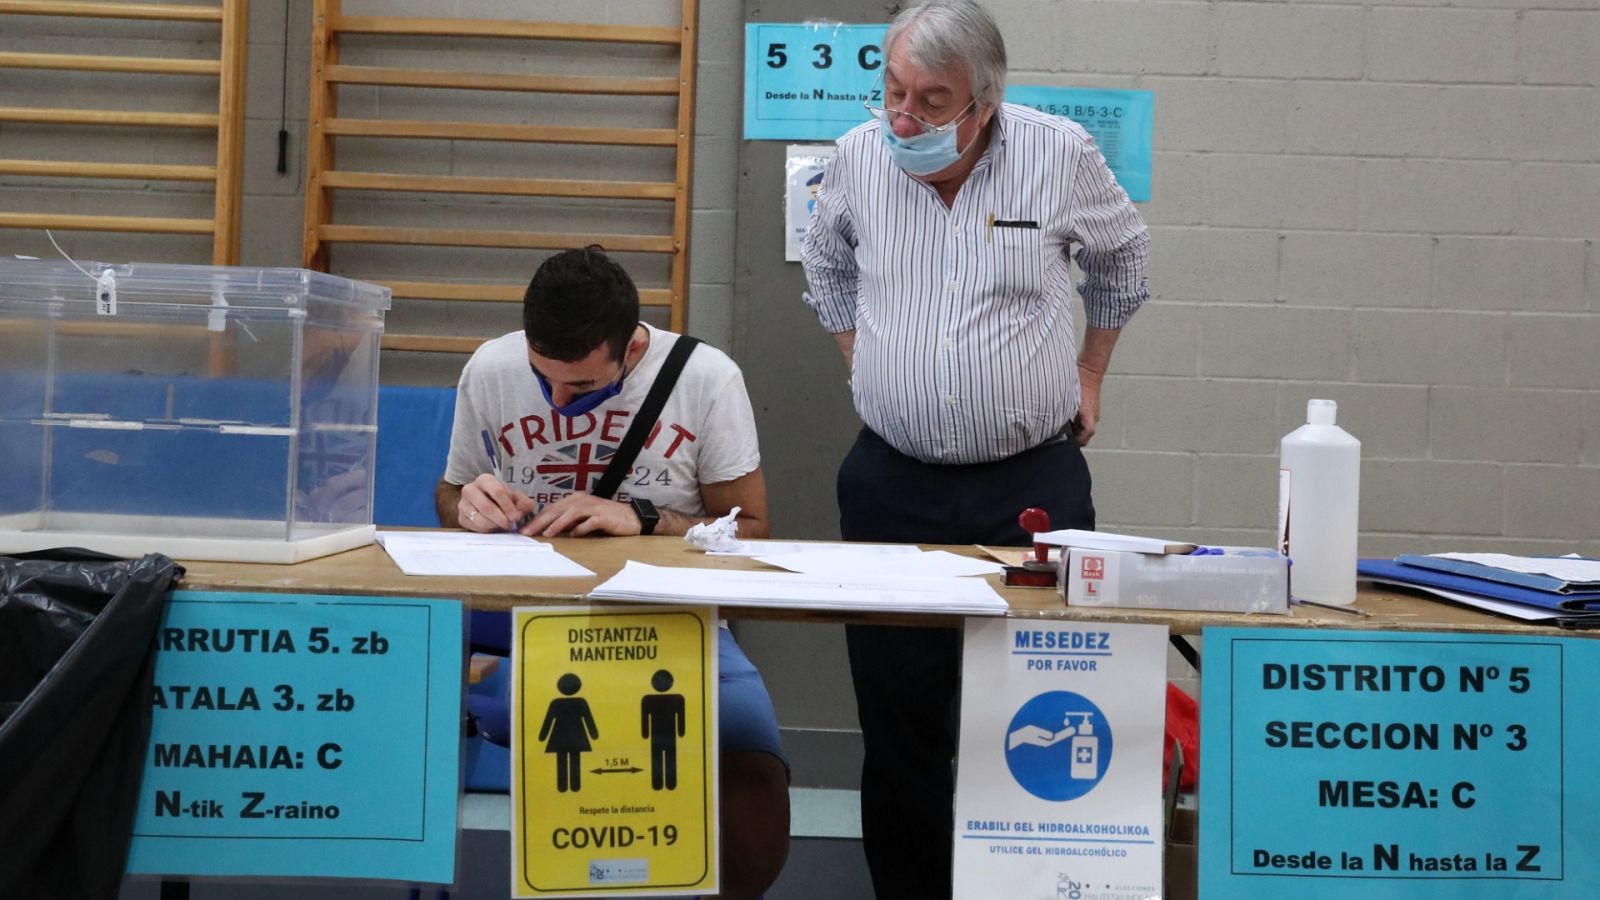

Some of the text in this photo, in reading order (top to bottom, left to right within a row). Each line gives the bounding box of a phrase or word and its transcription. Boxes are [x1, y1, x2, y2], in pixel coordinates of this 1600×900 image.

[767, 43, 881, 70] 5 3 C
[766, 92, 797, 100] Desde
[813, 89, 824, 99] N
[827, 92, 856, 100] hasta
[859, 93, 868, 101] la
[871, 90, 881, 101] Z
[507, 466, 672, 487] 19 24
[1087, 582, 1097, 593] L
[308, 627, 340, 654] 5.
[351, 631, 389, 655] zb
[568, 626, 659, 643] DISTANTZIA
[1015, 630, 1110, 650] MESEDEZ
[570, 645, 658, 662] MANTENDU
[1027, 659, 1097, 671] POR FAVOR
[1262, 663, 1446, 692] DISTRITO
[1508, 667, 1531, 693] 5
[273, 684, 305, 712] 3.
[316, 688, 355, 712] zb
[1264, 720, 1439, 750] SECCION
[1505, 724, 1528, 751] 3
[154, 742, 343, 770] MAHAIA: C
[605, 758, 630, 768] 1,5 M
[155, 790, 340, 819] N-tik Z-raino
[1318, 780, 1476, 809] MESA: C
[579, 804, 655, 816] Respete la distancia
[552, 824, 678, 850] COVID-19
[967, 820, 1150, 836] ERABILI GEL HIDROALKOHOLIKOA
[990, 845, 1127, 858] UTILICE GEL HIDROALCOHÓLICO
[1253, 844, 1541, 872] Desde la N hasta la Z
